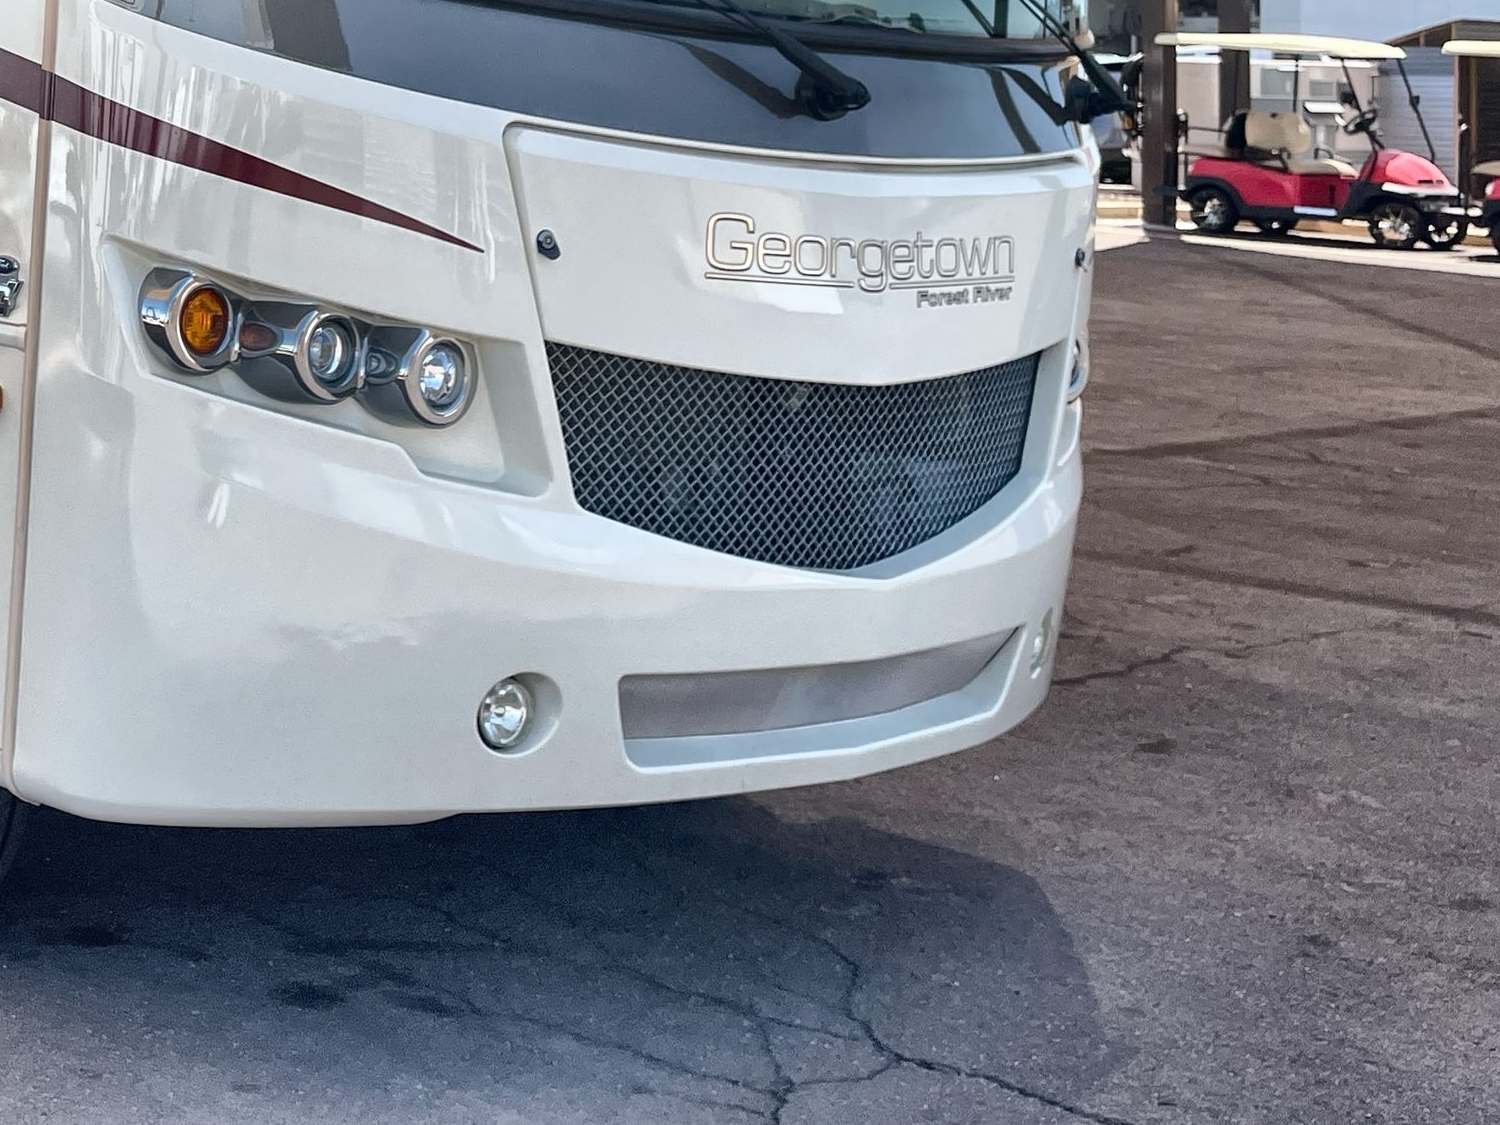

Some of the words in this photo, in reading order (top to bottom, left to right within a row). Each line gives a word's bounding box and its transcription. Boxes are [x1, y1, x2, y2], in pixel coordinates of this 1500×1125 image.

[705, 212, 1014, 293] Georgetown
[916, 288, 969, 308] Forest
[973, 286, 1012, 303] River
